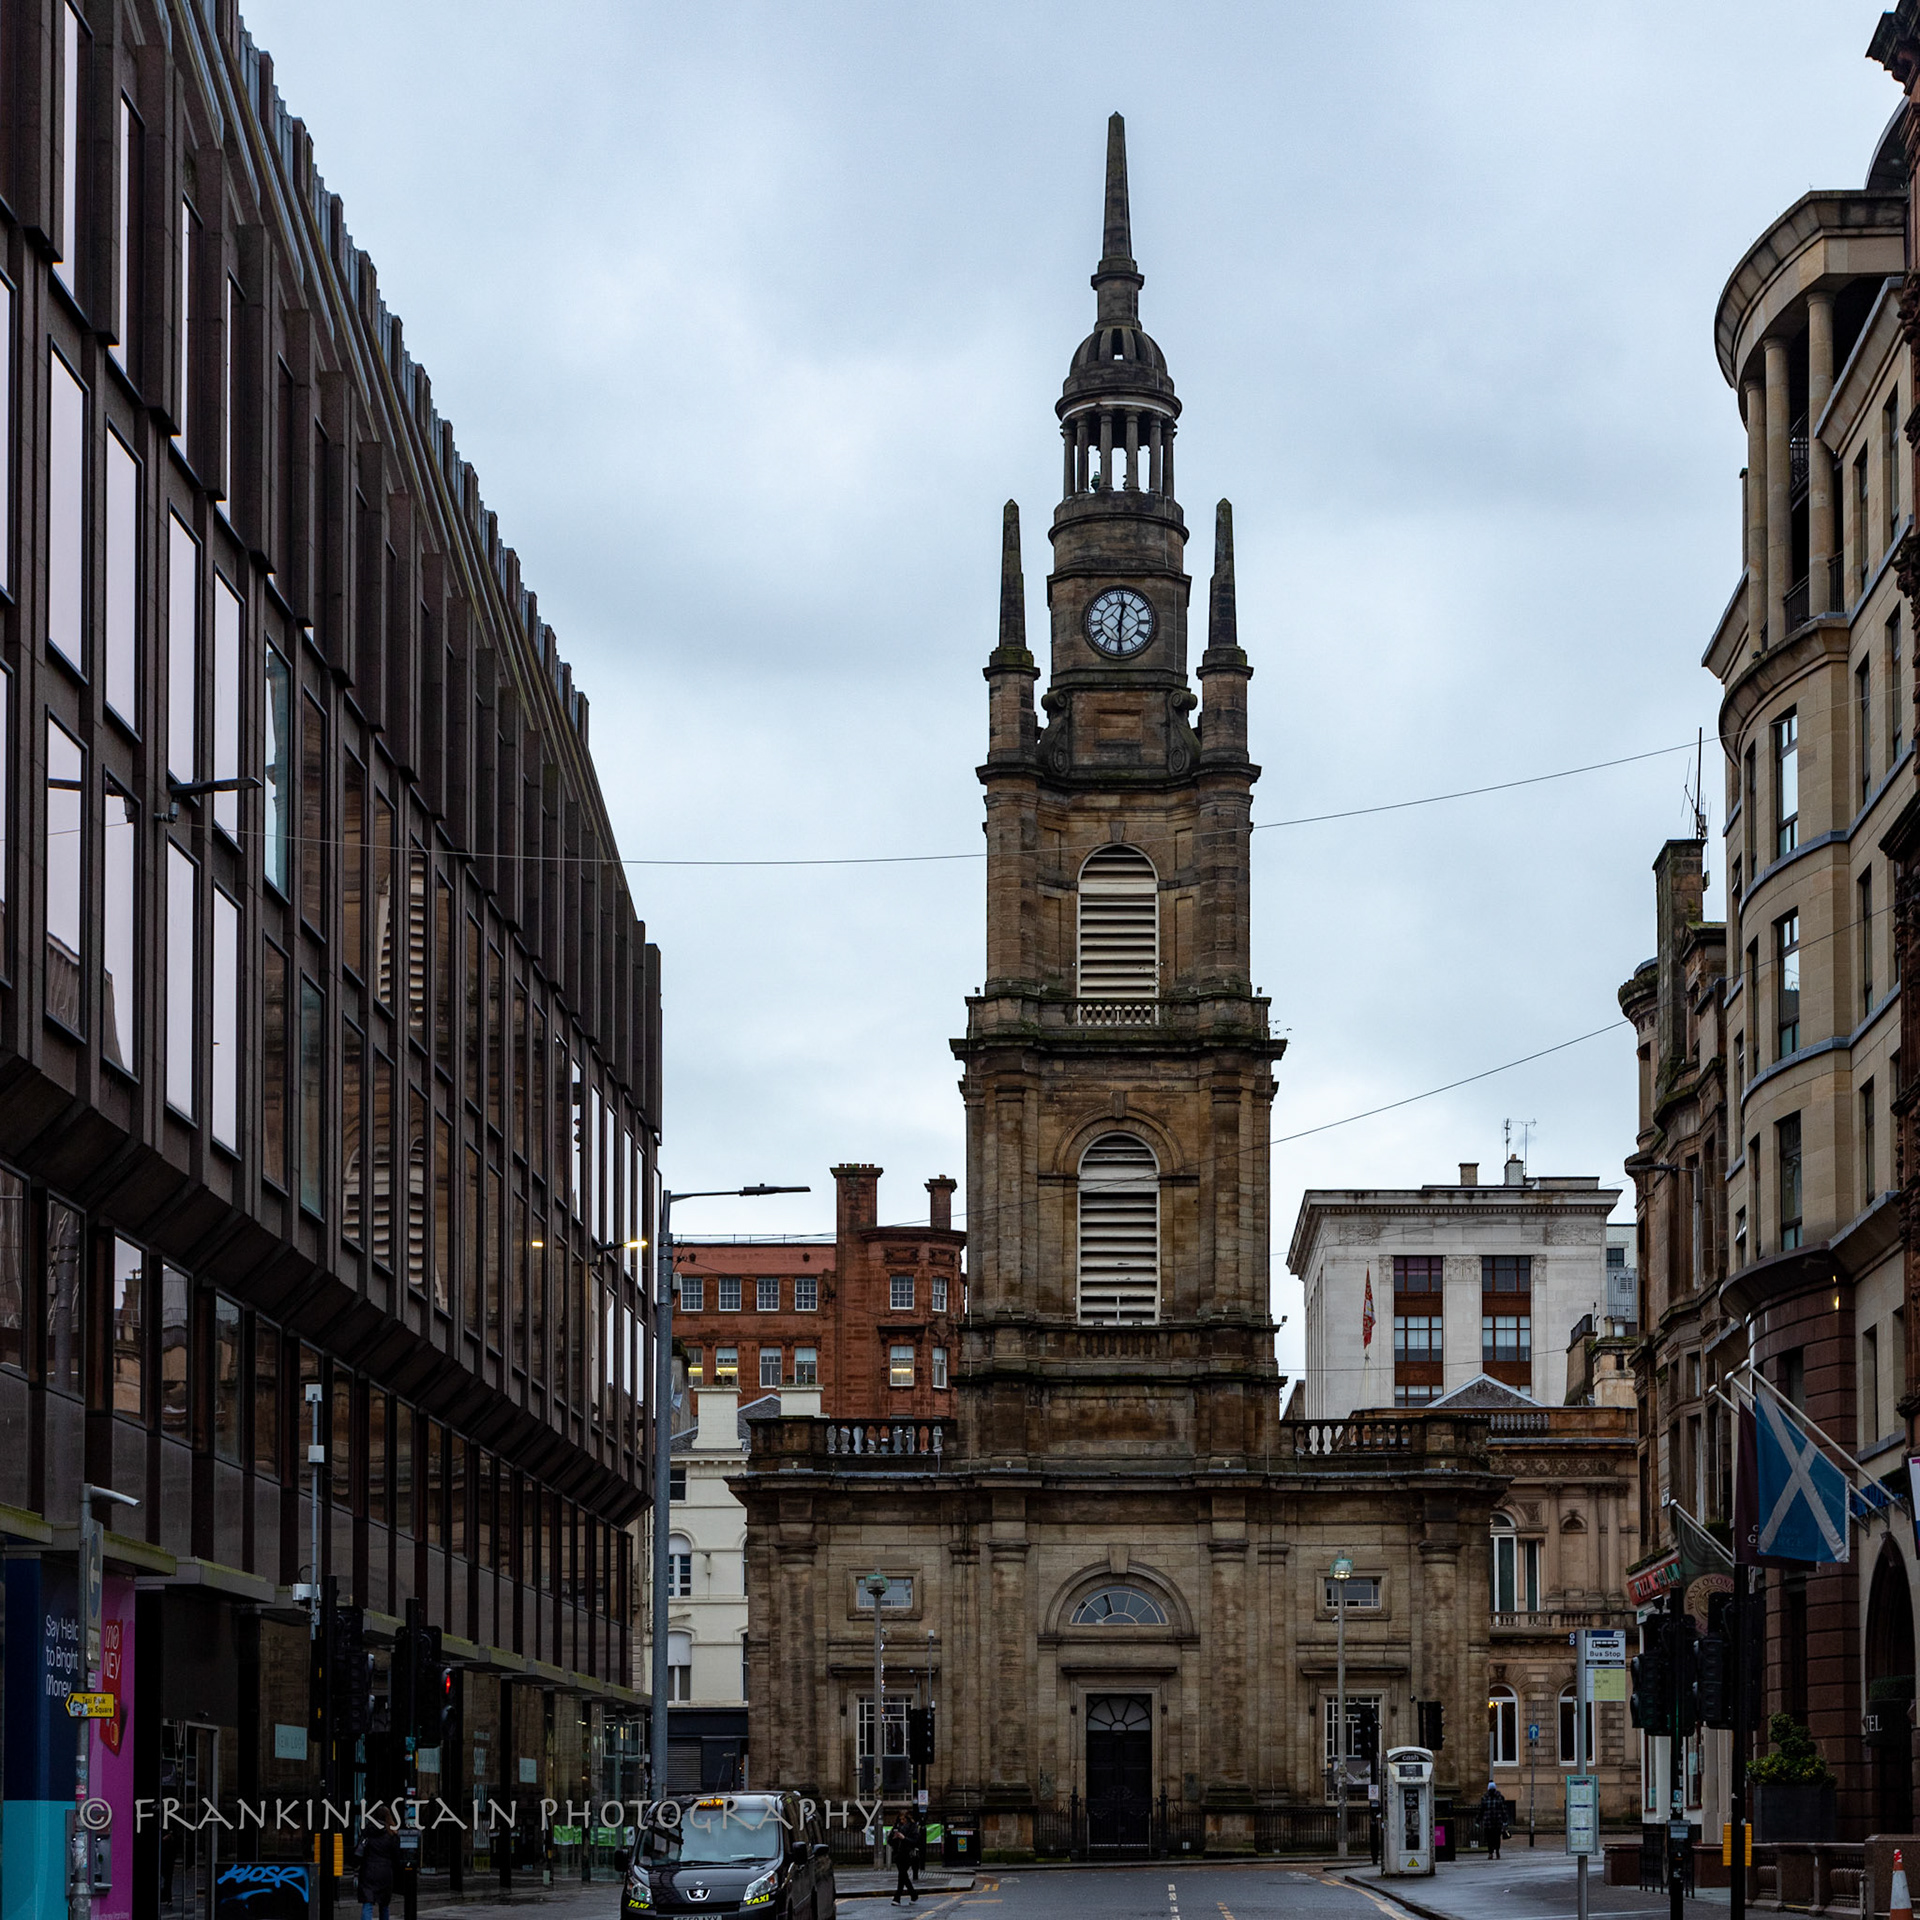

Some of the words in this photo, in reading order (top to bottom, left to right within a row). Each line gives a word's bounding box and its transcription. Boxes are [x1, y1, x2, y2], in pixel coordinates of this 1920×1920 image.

[1687, 1582, 1702, 1610] WAXY
[45, 1615, 60, 1643] Say
[46, 1645, 55, 1667] to
[56, 1646, 79, 1675] Bright
[46, 1674, 72, 1698] Money
[627, 1899, 650, 1910] TAXI
[746, 1894, 770, 1905] TAXI
